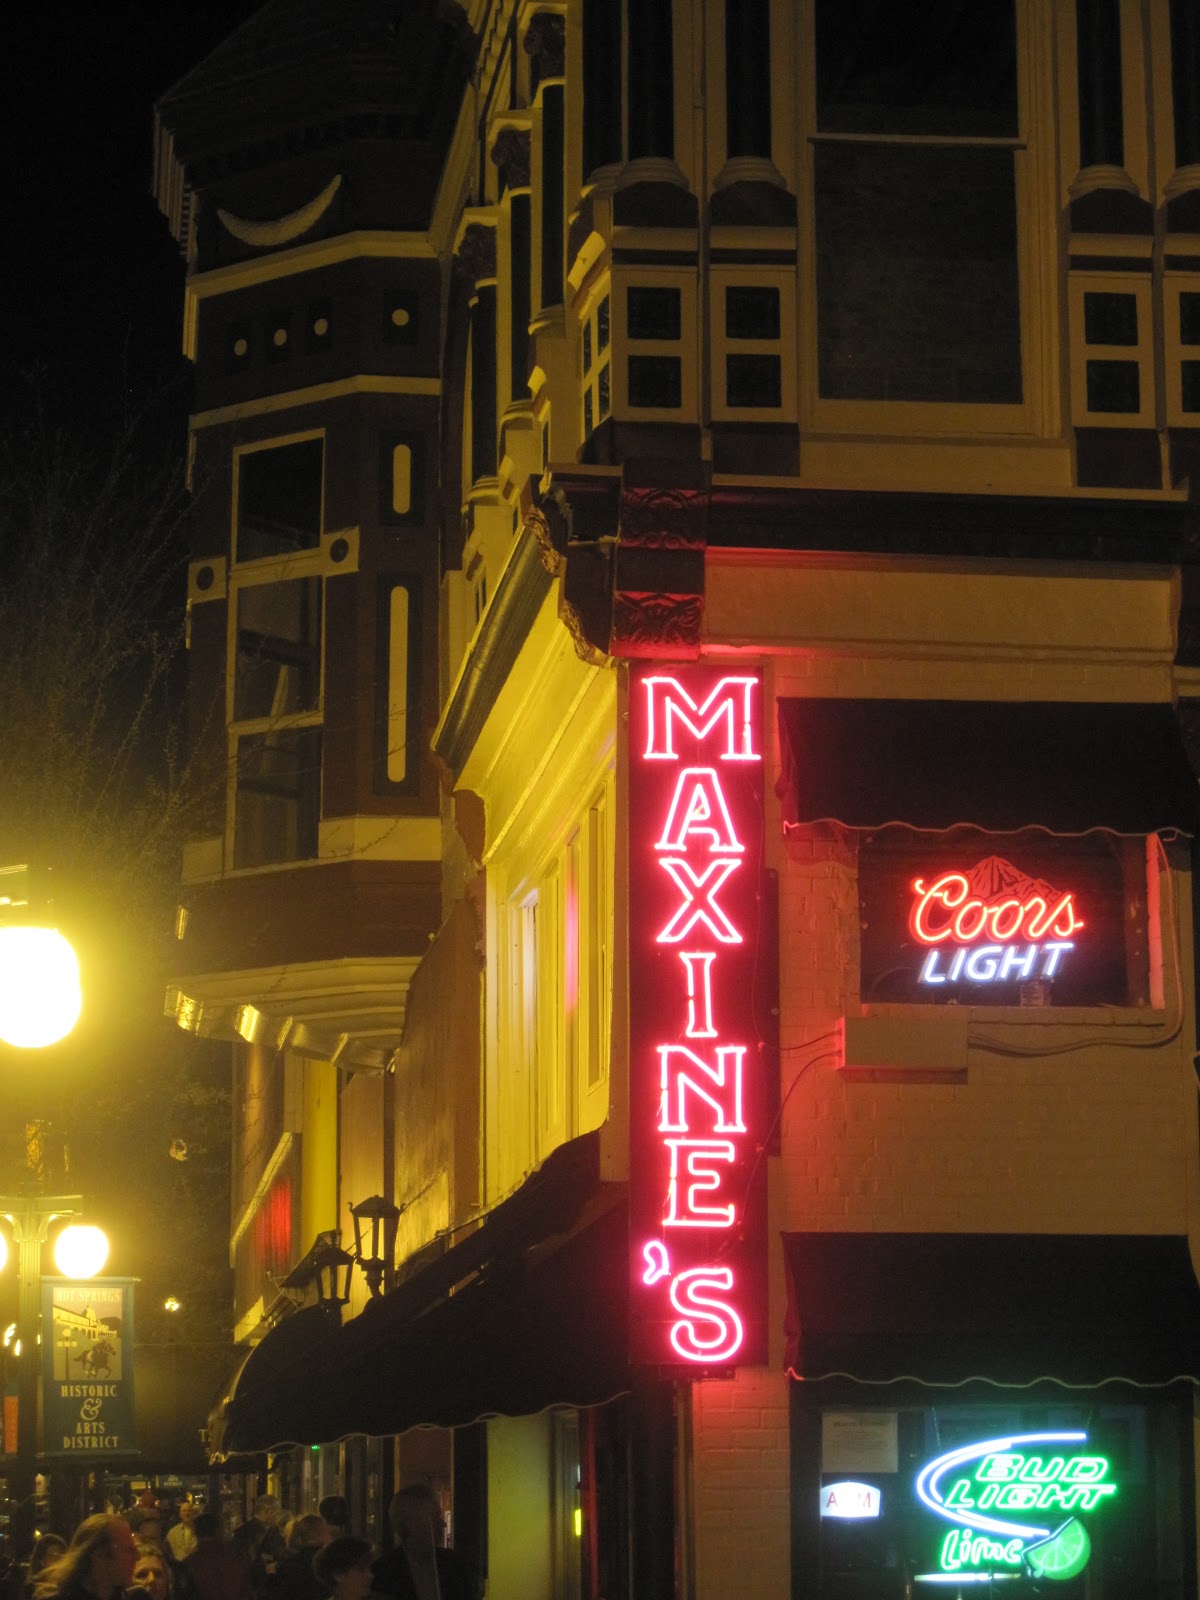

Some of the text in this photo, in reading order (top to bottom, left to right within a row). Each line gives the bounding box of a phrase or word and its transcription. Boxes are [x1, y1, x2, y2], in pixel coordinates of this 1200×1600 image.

[910, 872, 1085, 944] Coors
[920, 942, 1076, 984] LIGHT
[641, 676, 762, 1365] MAXINE'S
[79, 1289, 120, 1302] SPRINGS
[61, 1385, 117, 1397] HISTORIC
[80, 1398, 102, 1420] &
[76, 1421, 105, 1434] ARTS
[63, 1436, 119, 1449] DISTRICT
[975, 1453, 1109, 1483] BUD
[825, 1491, 872, 1509] AM
[943, 1479, 1117, 1510] LIGHT
[940, 1528, 1024, 1571] Lime
